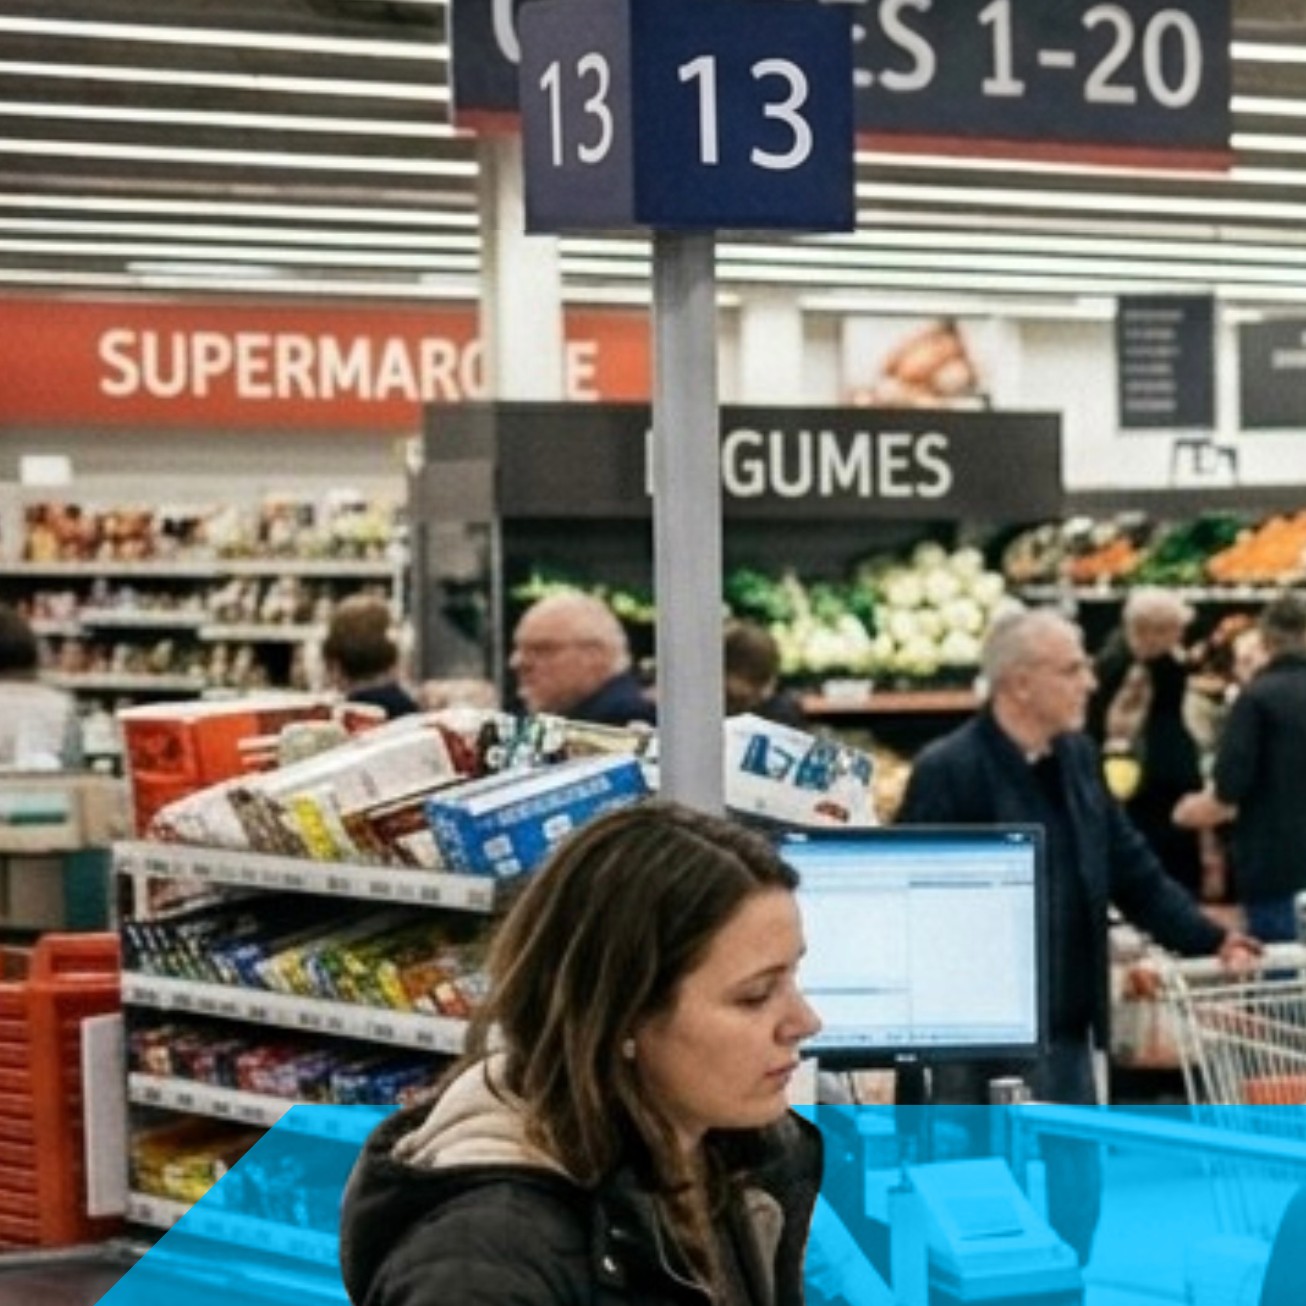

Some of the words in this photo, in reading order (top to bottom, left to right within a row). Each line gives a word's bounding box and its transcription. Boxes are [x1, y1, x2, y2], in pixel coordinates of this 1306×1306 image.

[539, 51, 614, 167] 13
[977, 0, 1202, 108] 1-20
[677, 54, 814, 170] 13
[645, 429, 954, 499] GUMES
